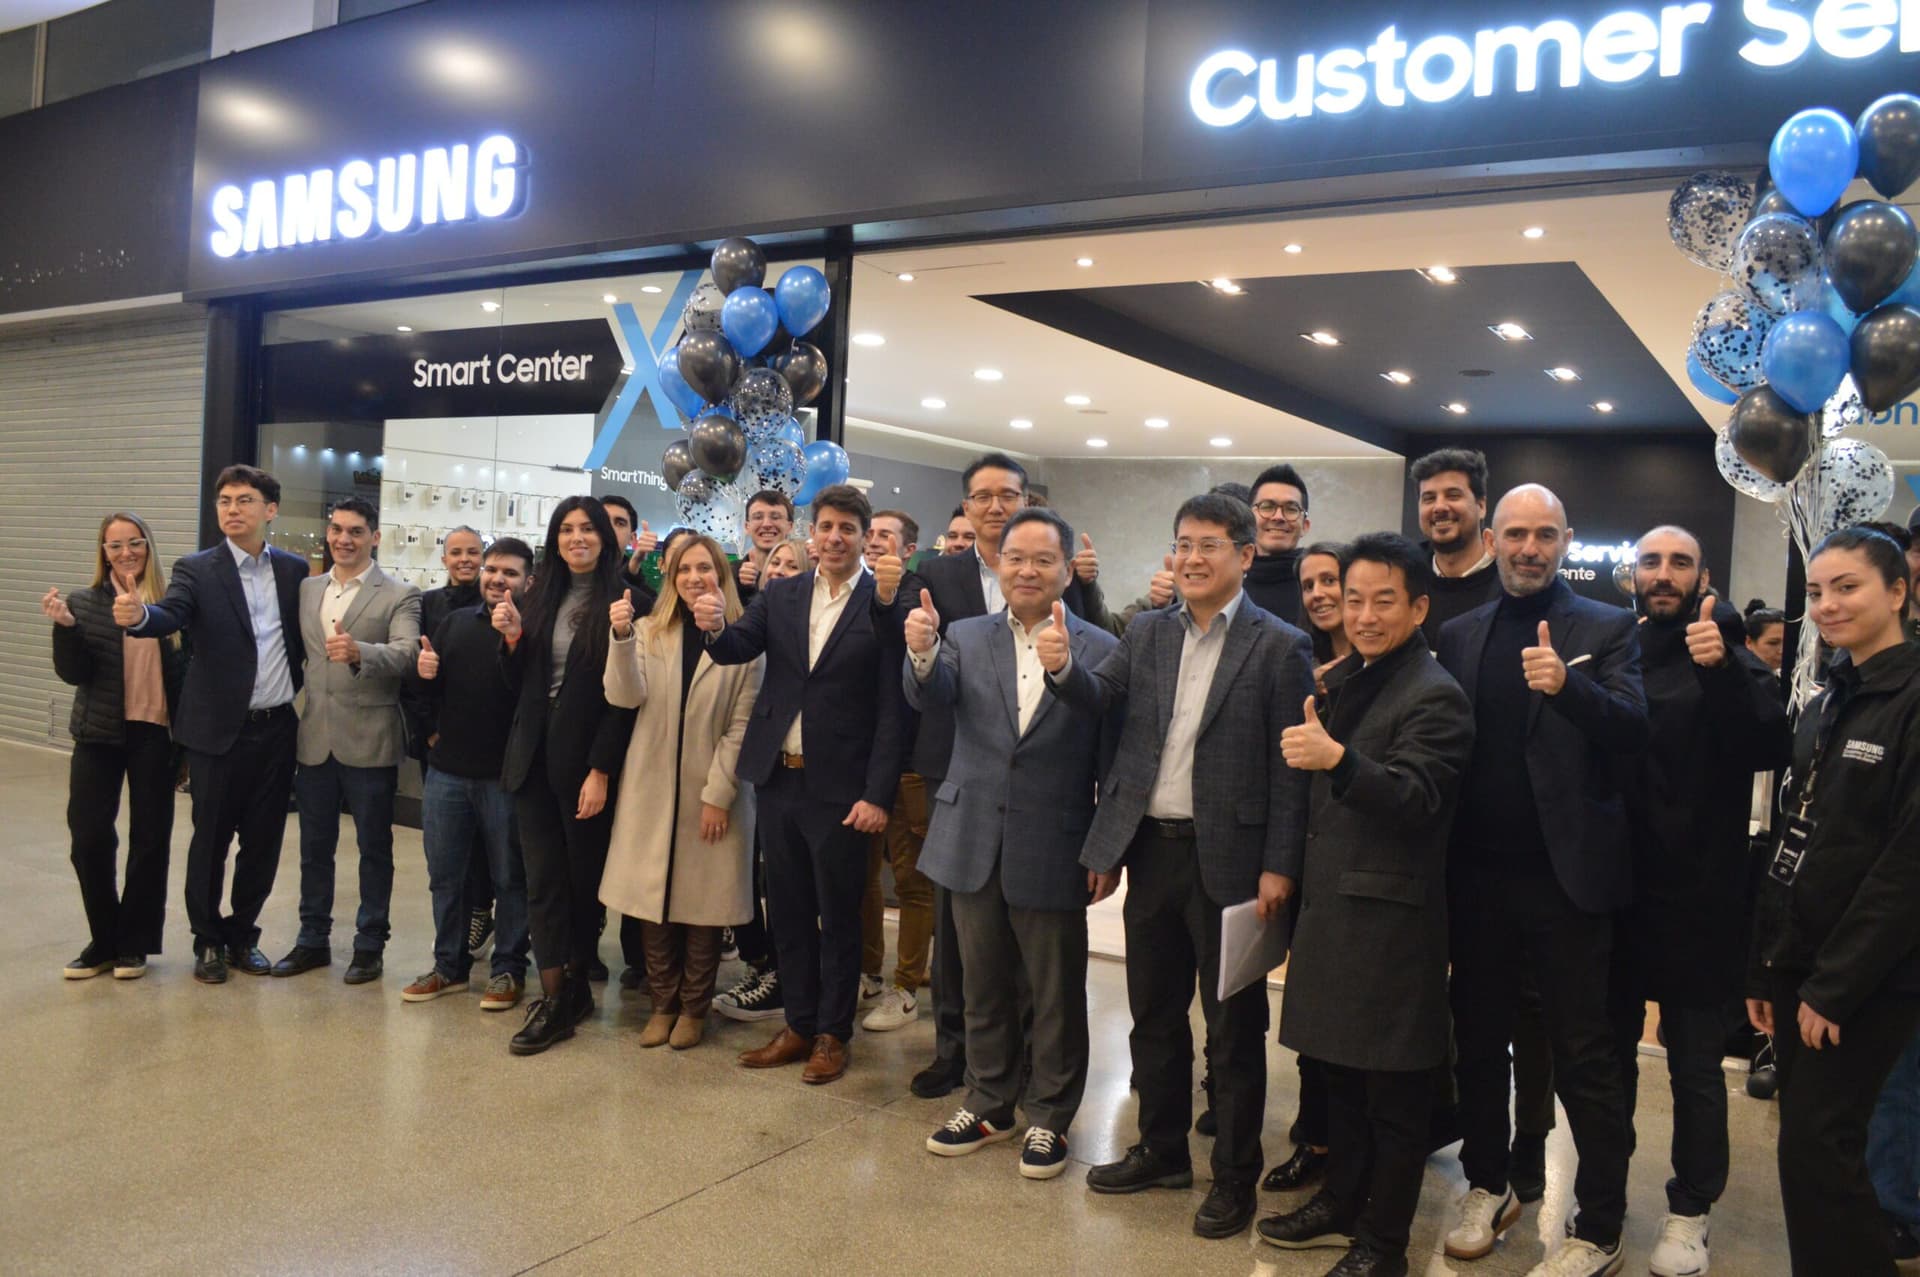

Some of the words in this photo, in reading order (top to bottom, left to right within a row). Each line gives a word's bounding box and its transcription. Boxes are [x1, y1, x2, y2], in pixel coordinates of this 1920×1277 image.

[1190, 2, 1711, 127] Customer
[210, 134, 519, 258] SAMSUNG
[413, 353, 491, 388] Smart
[496, 349, 593, 384] Center
[600, 466, 669, 492] SmartThing
[1557, 566, 1597, 581] ente
[1845, 739, 1885, 756] SAMSUNG
